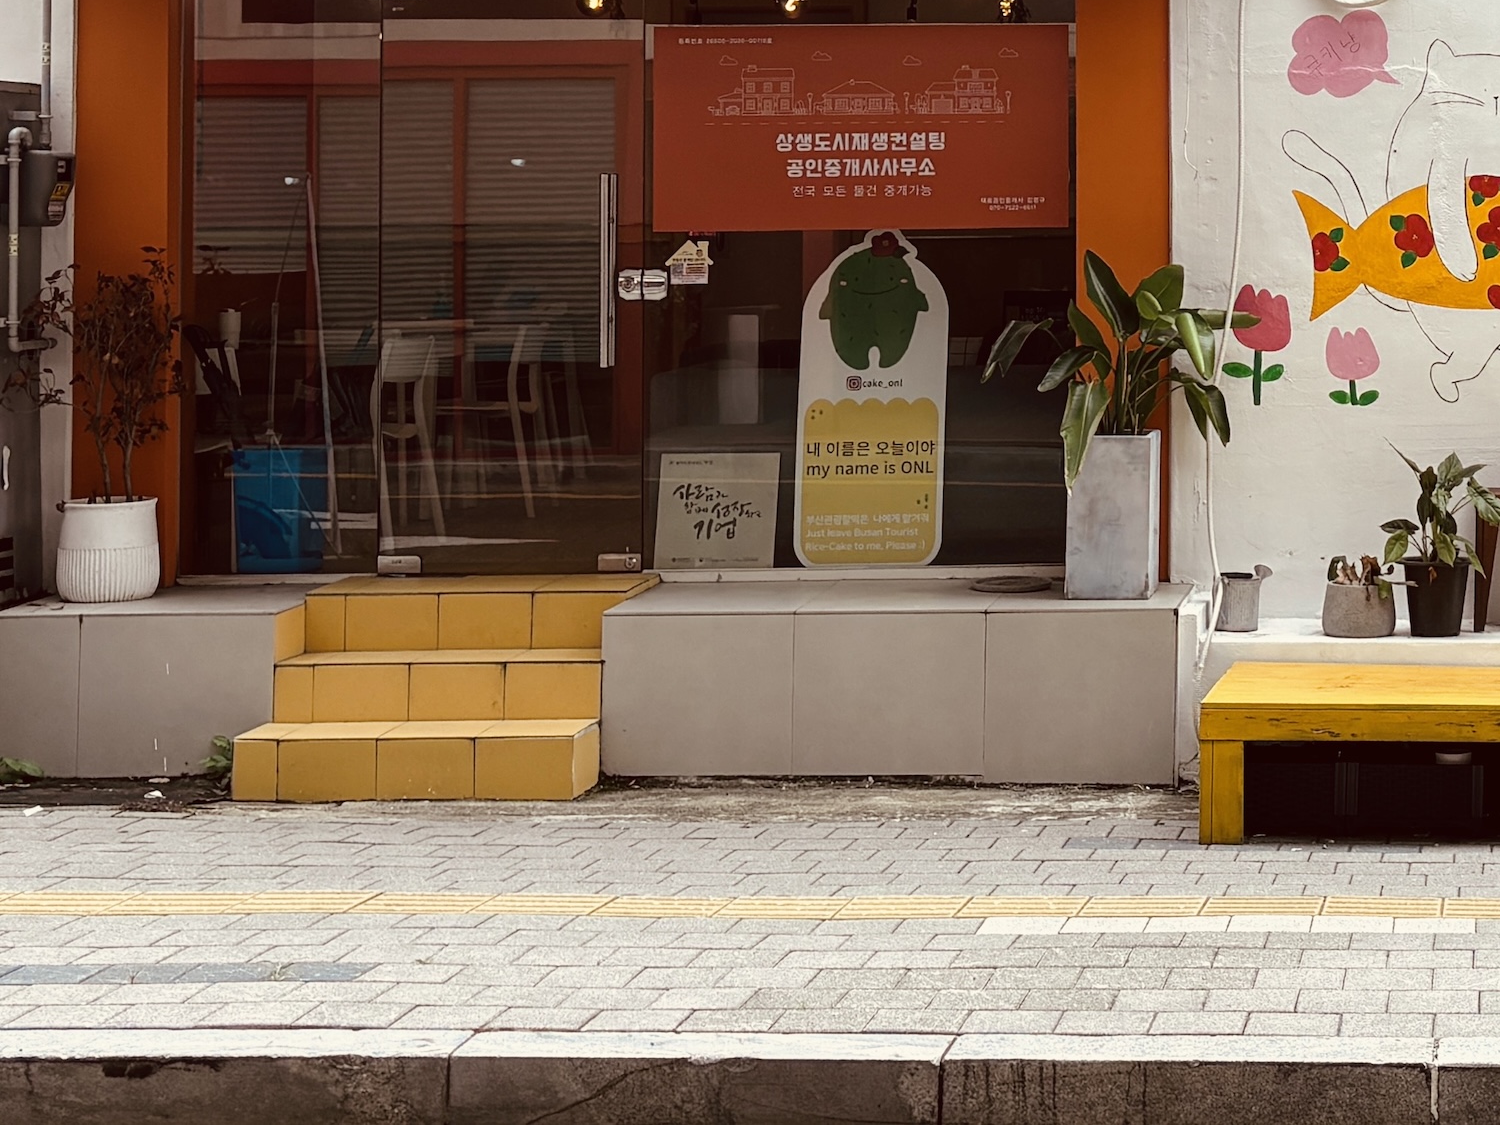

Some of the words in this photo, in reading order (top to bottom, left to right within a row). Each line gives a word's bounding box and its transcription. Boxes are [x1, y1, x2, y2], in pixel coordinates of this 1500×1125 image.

[775, 131, 946, 152] 상생도시재생컨설팅
[786, 157, 936, 178] 공인중개사사무소
[792, 185, 816, 198] 전국
[823, 185, 847, 198] 모든
[854, 185, 877, 197] 물건
[884, 184, 933, 197] 중개가능
[862, 378, 903, 389] cake_onl
[806, 441, 820, 457] 내
[827, 441, 870, 457] 이름은
[875, 440, 936, 456] 오늘이야
[806, 464, 831, 479] my
[835, 464, 879, 475] name
[884, 460, 896, 474] is
[901, 460, 934, 474] ONL
[806, 529, 825, 538] Just
[854, 528, 883, 537] Busan
[886, 528, 919, 536] Tourist
[854, 542, 865, 550] to
[886, 541, 917, 550] Please
